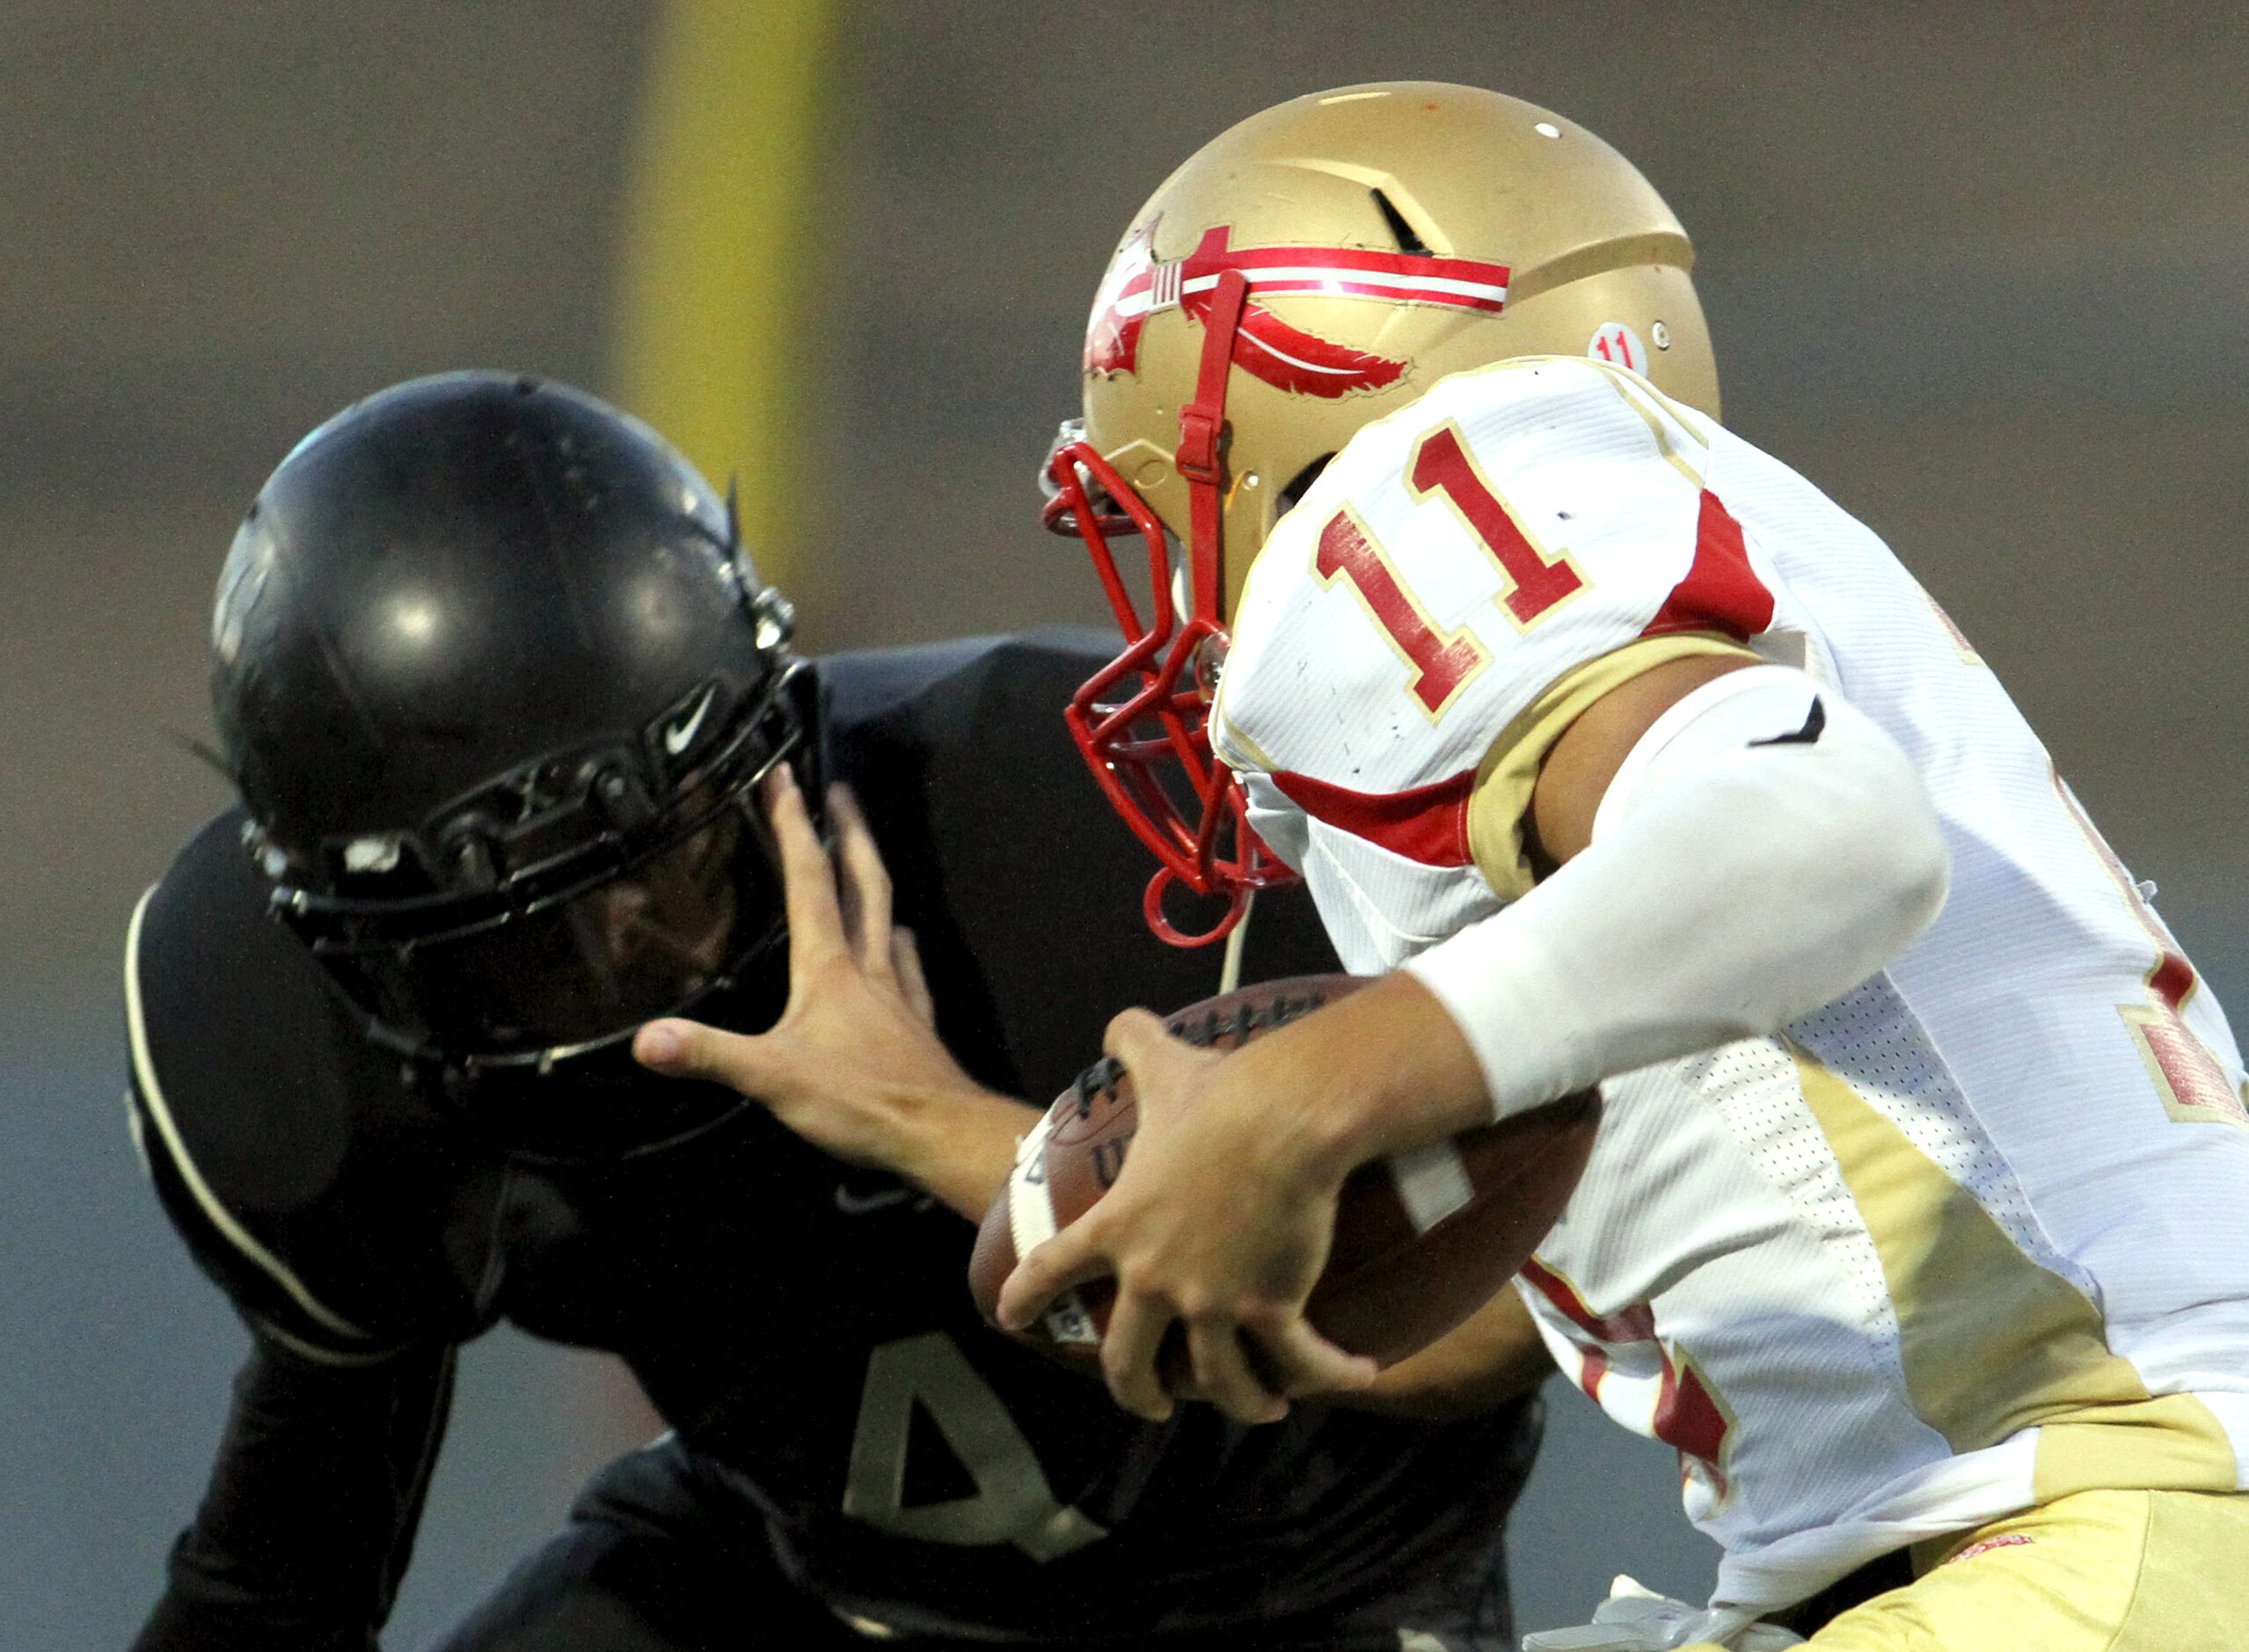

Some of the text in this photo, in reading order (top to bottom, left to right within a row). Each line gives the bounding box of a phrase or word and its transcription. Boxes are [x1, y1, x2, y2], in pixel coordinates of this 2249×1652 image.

[1596, 331, 1633, 369] 11
[1311, 419, 1587, 724] 11
[841, 1327, 1112, 1564] 4
